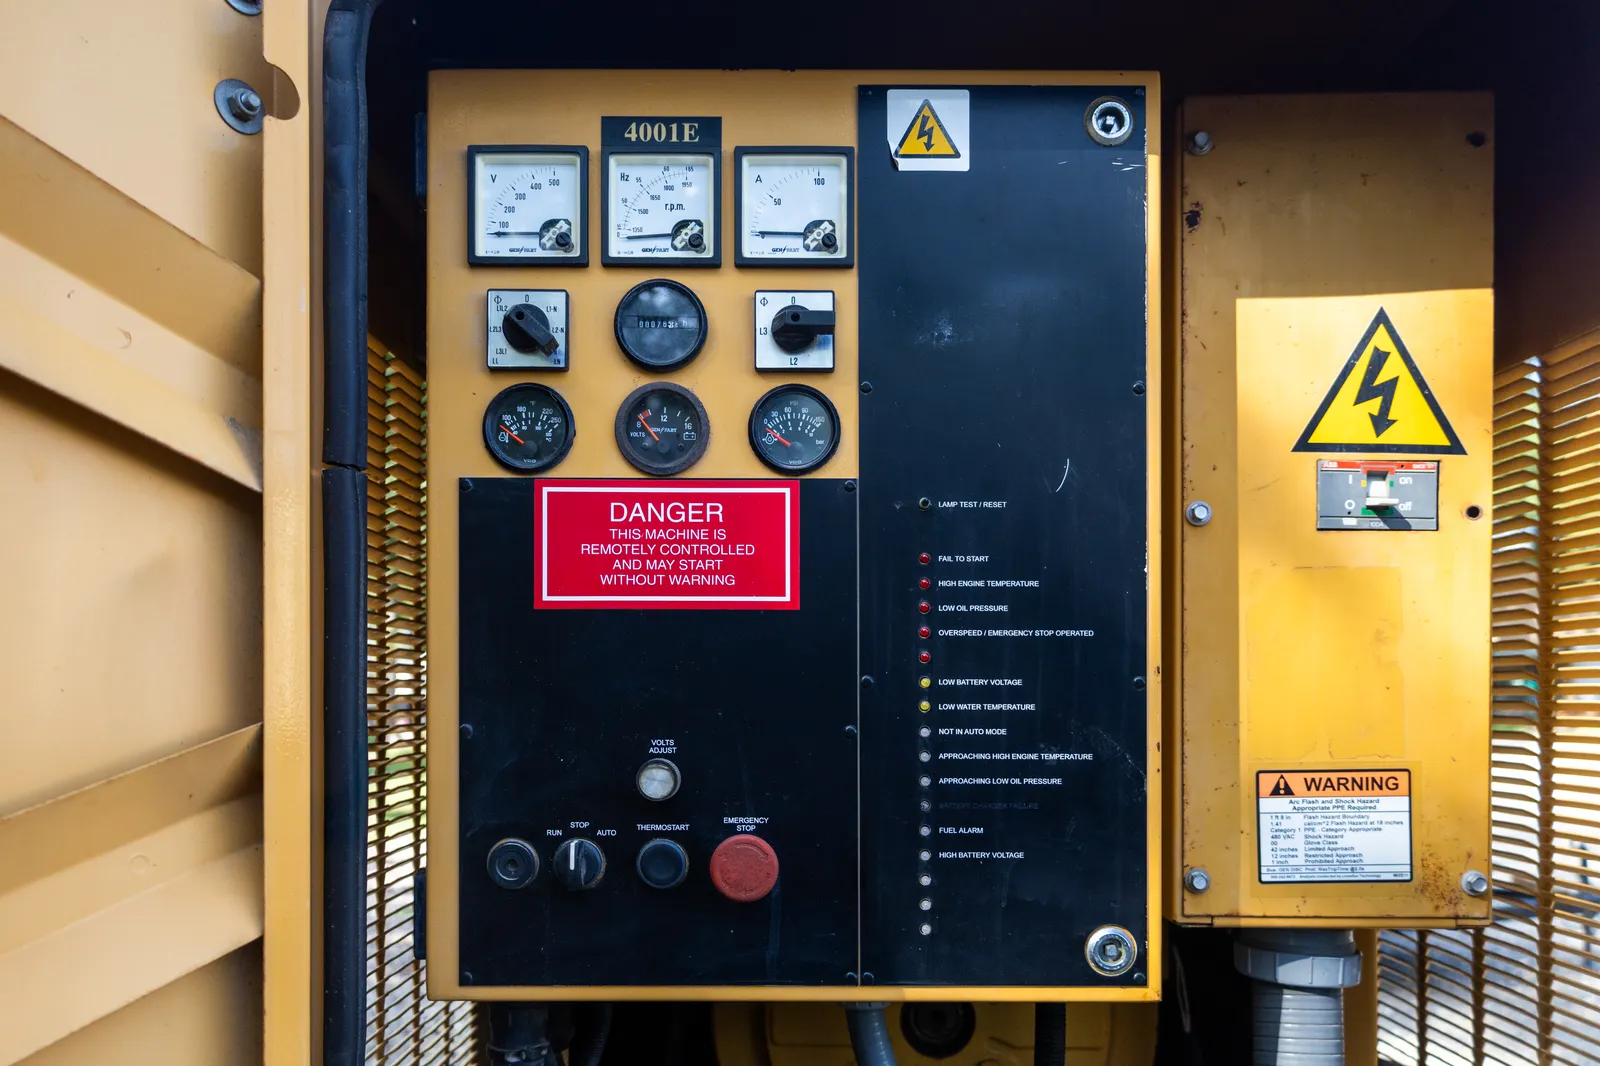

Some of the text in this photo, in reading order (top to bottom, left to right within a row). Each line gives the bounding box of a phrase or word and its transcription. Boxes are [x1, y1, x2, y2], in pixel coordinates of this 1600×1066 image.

[624, 122, 699, 142] 4001E
[490, 174, 497, 183] V
[620, 173, 629, 182] Hz
[755, 175, 762, 183] A
[665, 203, 685, 212] r.p.m.
[760, 327, 767, 335] L3
[790, 357, 798, 365] L2
[1399, 501, 1412, 511] off
[610, 503, 724, 523] DANGER
[610, 529, 726, 540] THIS MACHINE IS
[581, 544, 755, 555] REMOTELY CONTROLLED
[613, 560, 723, 570] AND MAY START
[600, 575, 735, 586] WITHOUT WARNING
[1304, 776, 1399, 791] WARNING
